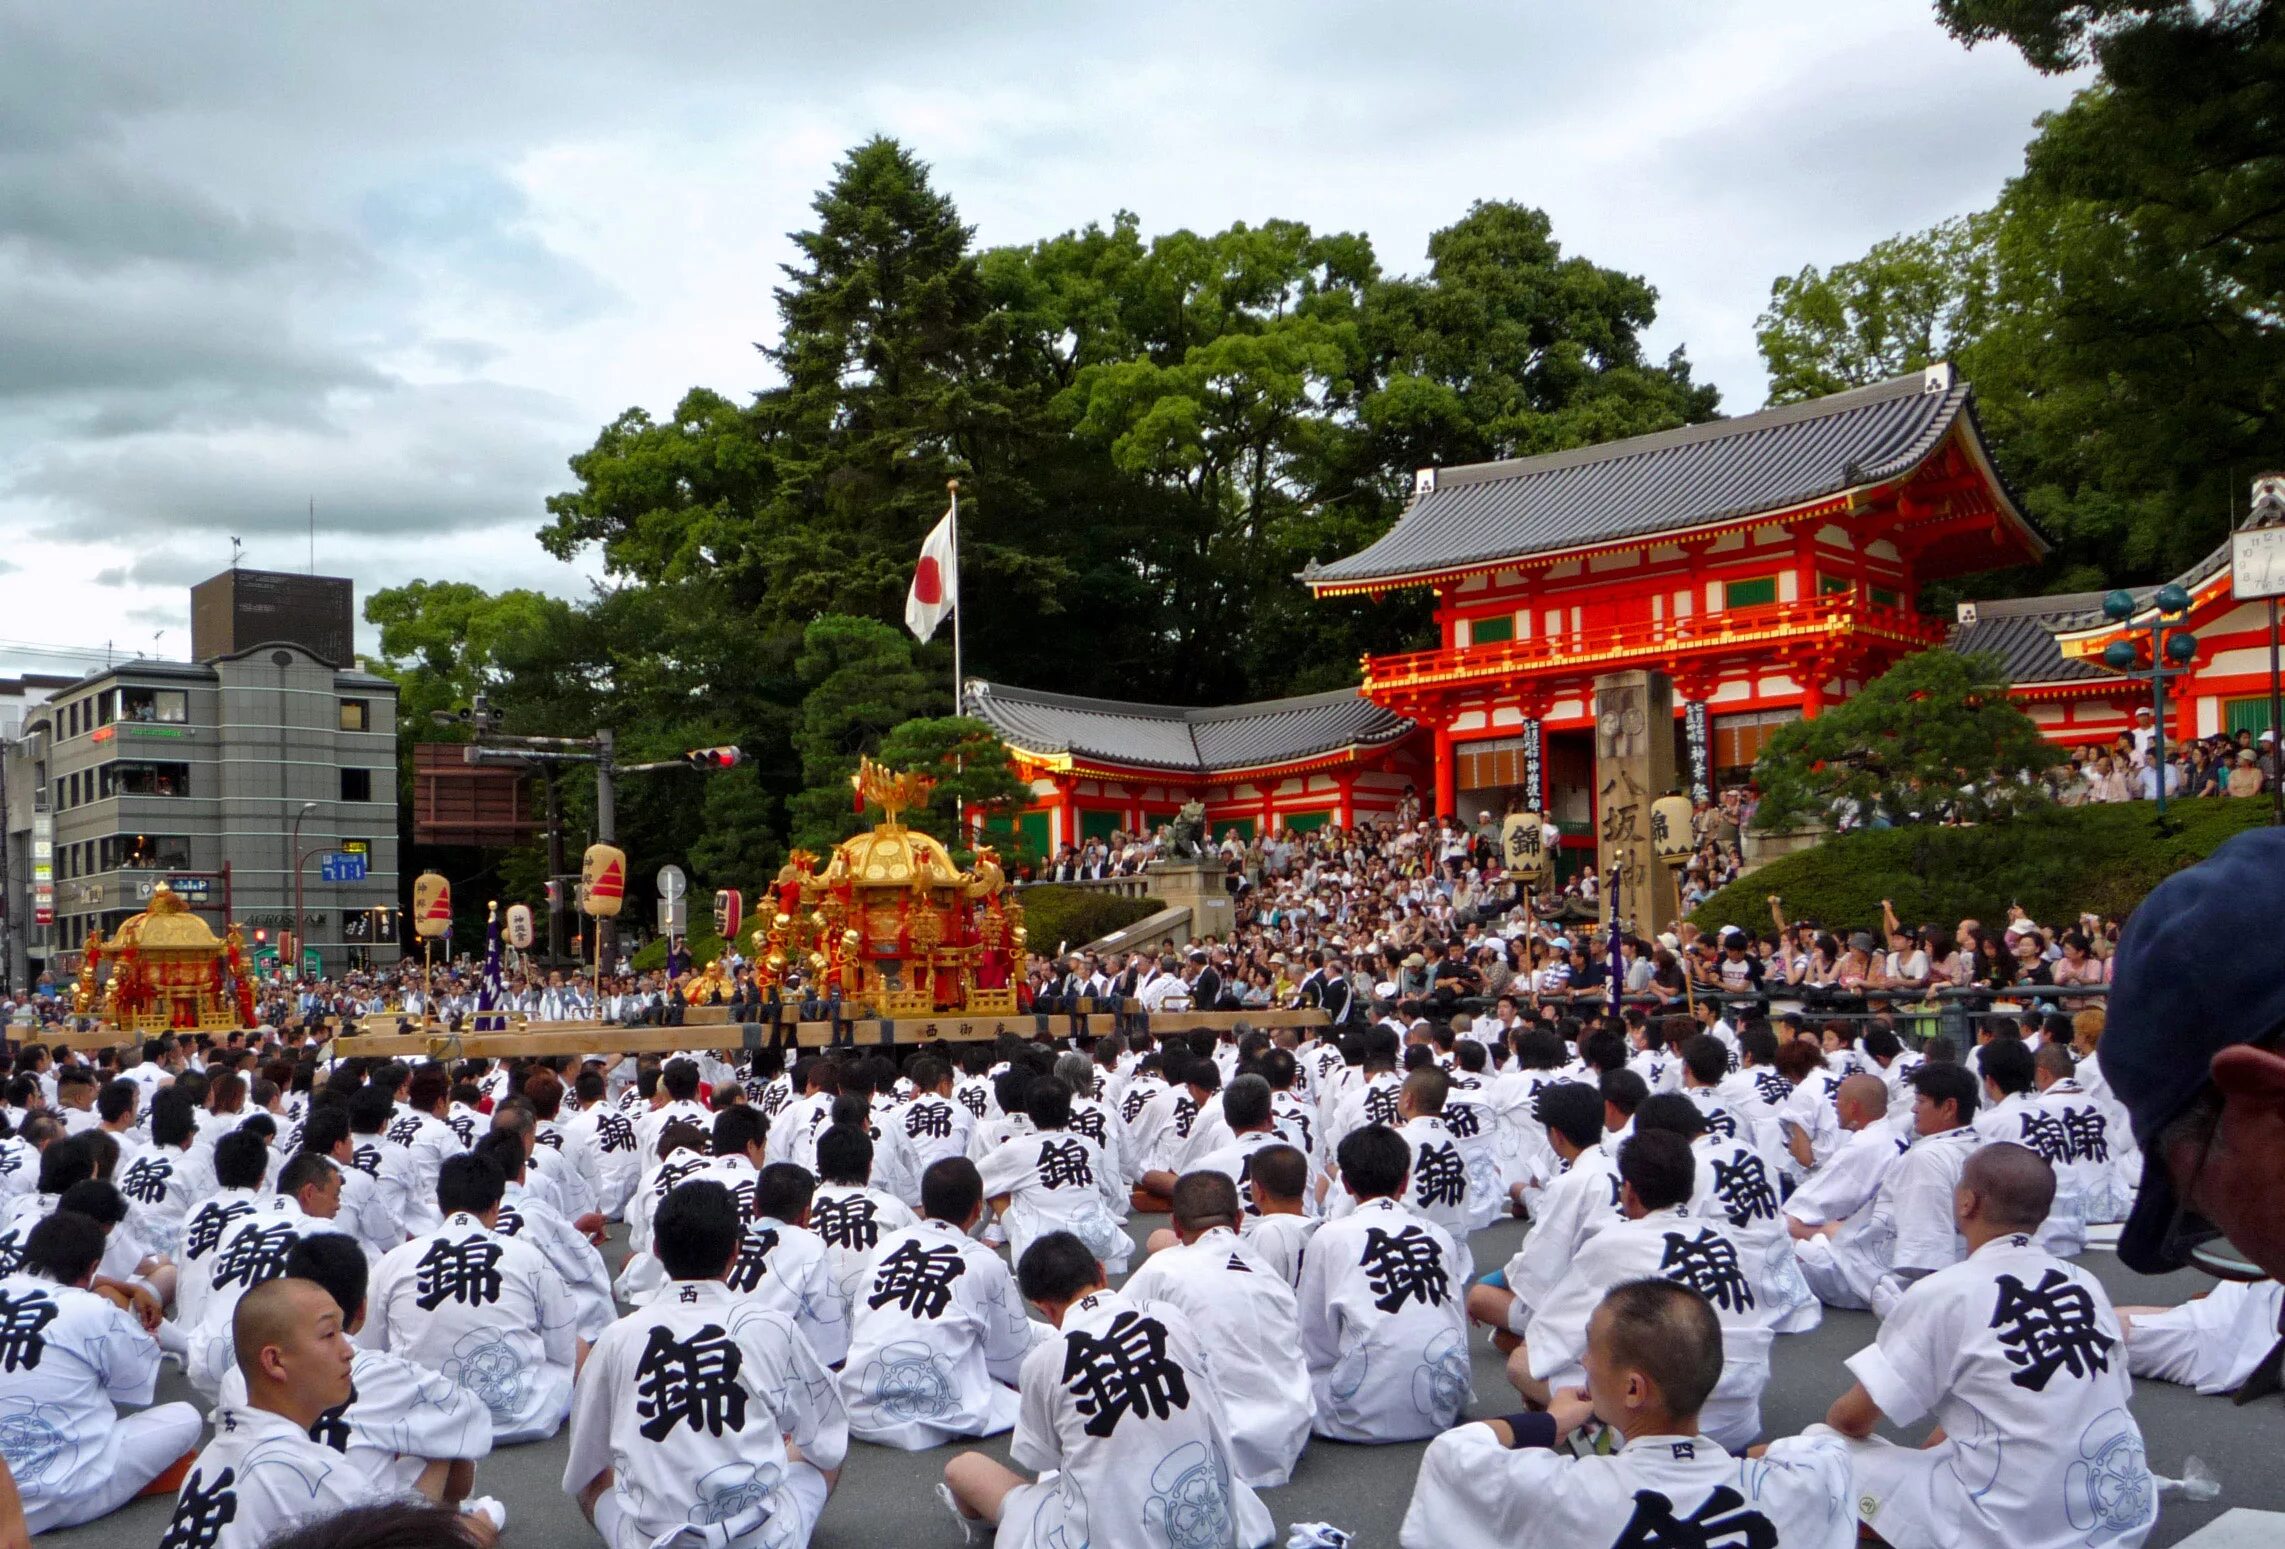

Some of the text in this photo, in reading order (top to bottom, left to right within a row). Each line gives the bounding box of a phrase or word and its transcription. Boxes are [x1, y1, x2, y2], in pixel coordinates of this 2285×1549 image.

[2243, 548, 2252, 558] 10
[2252, 538, 2260, 547] 11
[2264, 531, 2272, 541] 12
[2277, 576, 2285, 586] 5
[1690, 746, 1709, 801] 神幸祭
[1509, 824, 1540, 857] 錦
[764, 1080, 789, 1117] 錦
[957, 1086, 988, 1118] 錦
[1363, 1084, 1404, 1125] 錦
[1755, 1071, 1796, 1106] 錦
[386, 1115, 423, 1149] 錦
[597, 1112, 637, 1153] 錦
[906, 1102, 954, 1138] 錦
[1014, 1114, 1022, 1123] 西
[2020, 1110, 2073, 1165] 錦
[2063, 1105, 2110, 1164] 錦
[122, 1157, 173, 1204] 錦
[1036, 1138, 1094, 1190] 錦
[1415, 1140, 1466, 1208] 錦
[274, 1198, 284, 1210] 西
[1711, 1149, 1778, 1228] 錦
[188, 1200, 258, 1260] 錦
[455, 1213, 468, 1226] 西
[809, 1193, 878, 1252] 錦
[212, 1221, 301, 1291] 錦
[416, 1233, 503, 1311] 錦
[1358, 1224, 1453, 1314] 錦
[1659, 1226, 1755, 1315] 錦
[680, 1285, 697, 1303] 西
[867, 1239, 967, 1320] 錦
[1080, 1295, 1099, 1311] 西
[1989, 1268, 2116, 1392] 錦
[634, 1324, 749, 1442] 錦
[1061, 1310, 1190, 1438] 錦
